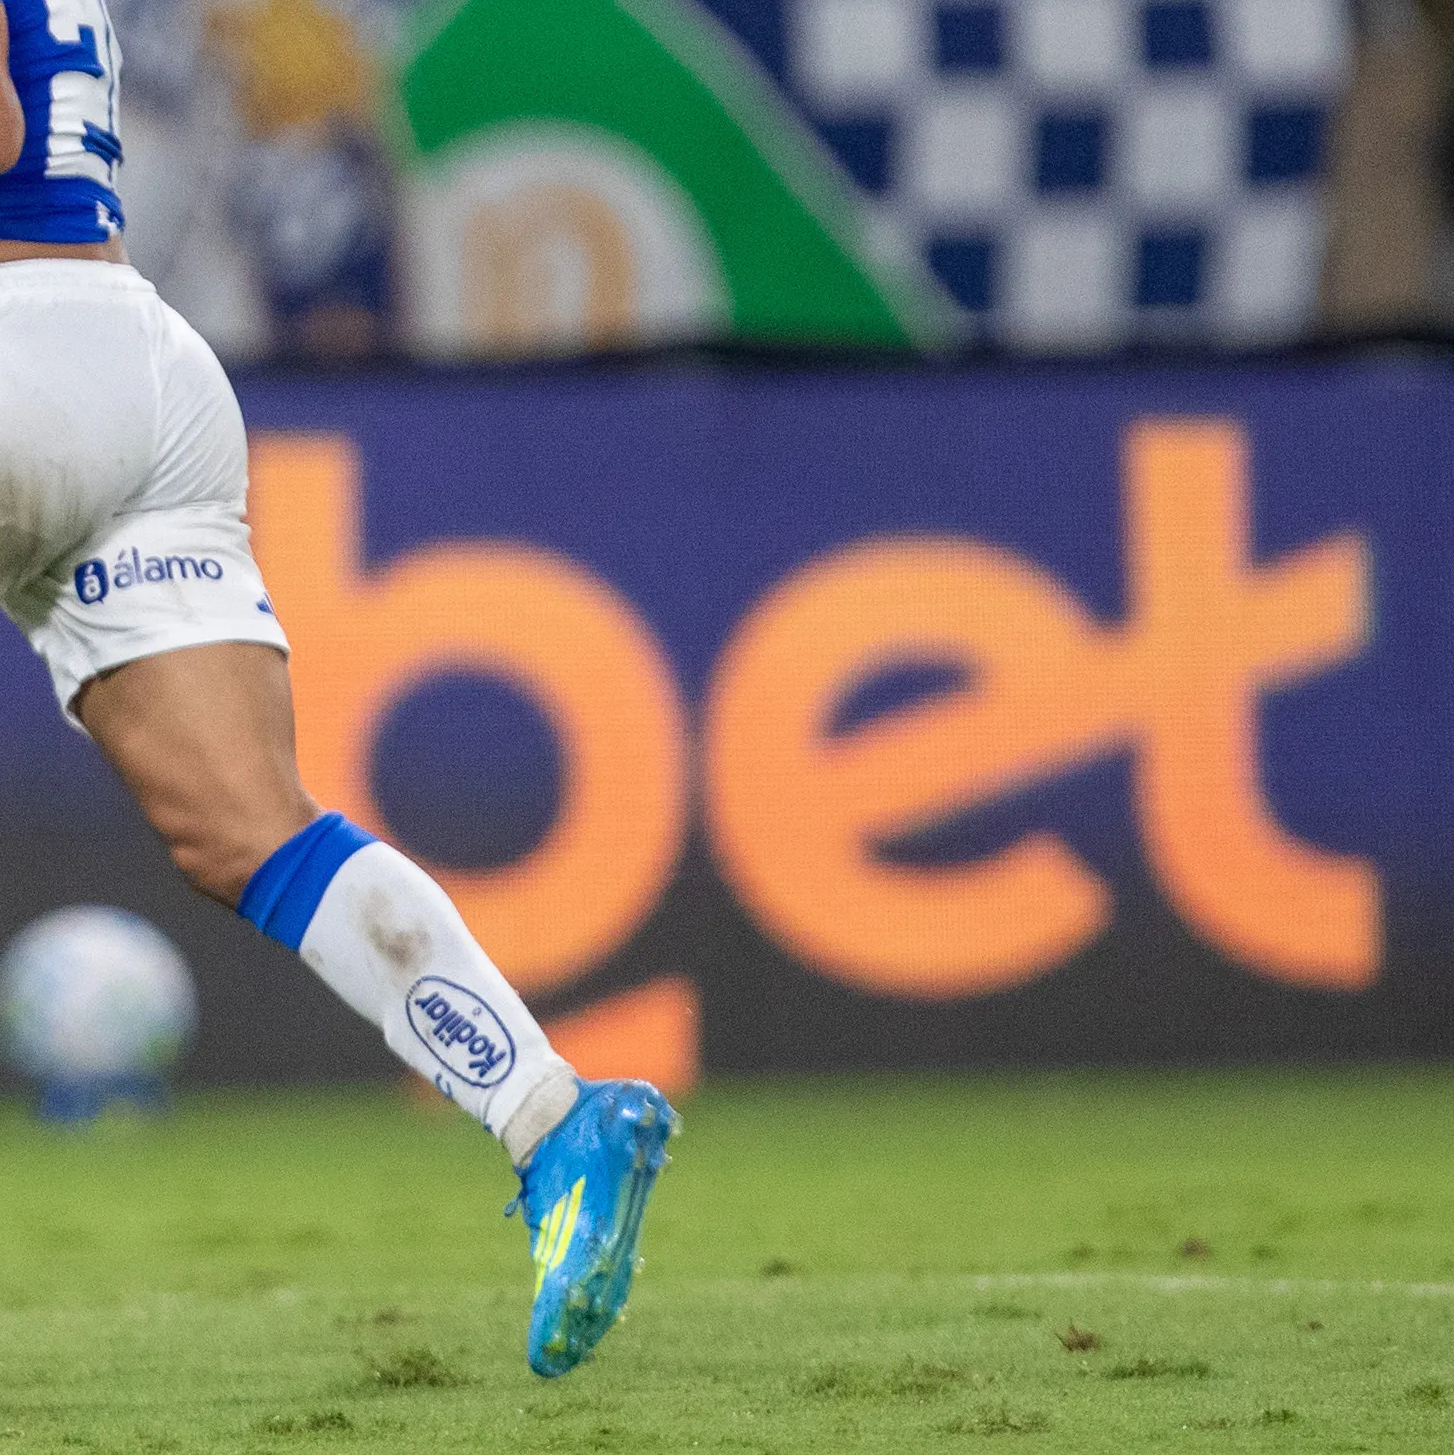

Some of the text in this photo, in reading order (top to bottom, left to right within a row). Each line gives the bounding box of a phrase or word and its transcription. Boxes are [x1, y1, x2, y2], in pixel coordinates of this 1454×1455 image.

[113, 546, 224, 589] álamo
[241, 416, 1388, 998] bet
[414, 990, 507, 1089] Kodilar
